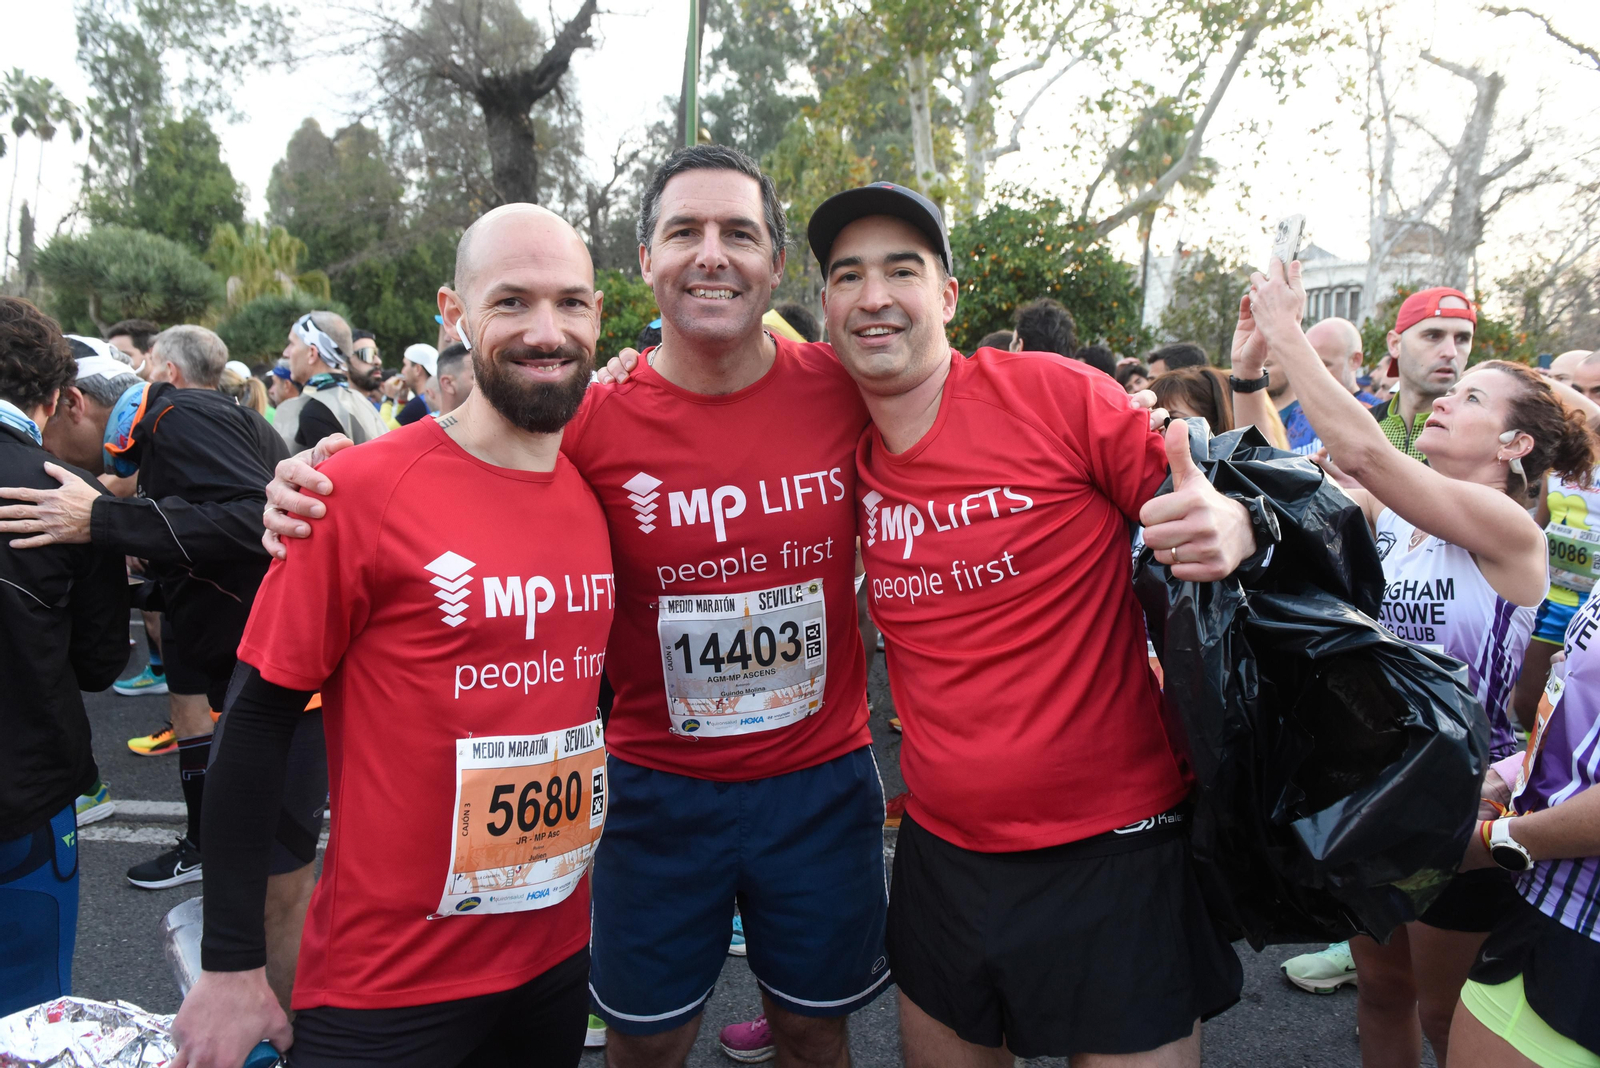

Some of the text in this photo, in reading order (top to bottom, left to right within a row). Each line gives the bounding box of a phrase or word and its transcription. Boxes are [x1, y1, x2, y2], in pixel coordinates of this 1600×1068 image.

[759, 467, 845, 514] LIFTS
[927, 486, 1034, 533] LIFTS
[656, 536, 834, 590] people first
[873, 551, 1020, 606] people first
[668, 585, 803, 614] MEDIO MARATÓN SEVILLA
[674, 621, 802, 674] 14403
[1396, 625, 1436, 642] CLUB
[454, 650, 565, 700] people
[665, 650, 674, 671] CAJÓN
[707, 668, 776, 683] AGM-MP ASCENS
[740, 715, 764, 726] HOKA
[472, 725, 595, 759] MEDIO MARATÓN SEVILLA
[486, 770, 582, 837] 5680
[462, 810, 471, 837] CAJÓN
[516, 834, 527, 845] JR
[534, 832, 547, 842] MP
[547, 830, 560, 839] Asc
[526, 887, 550, 901] HOKA
